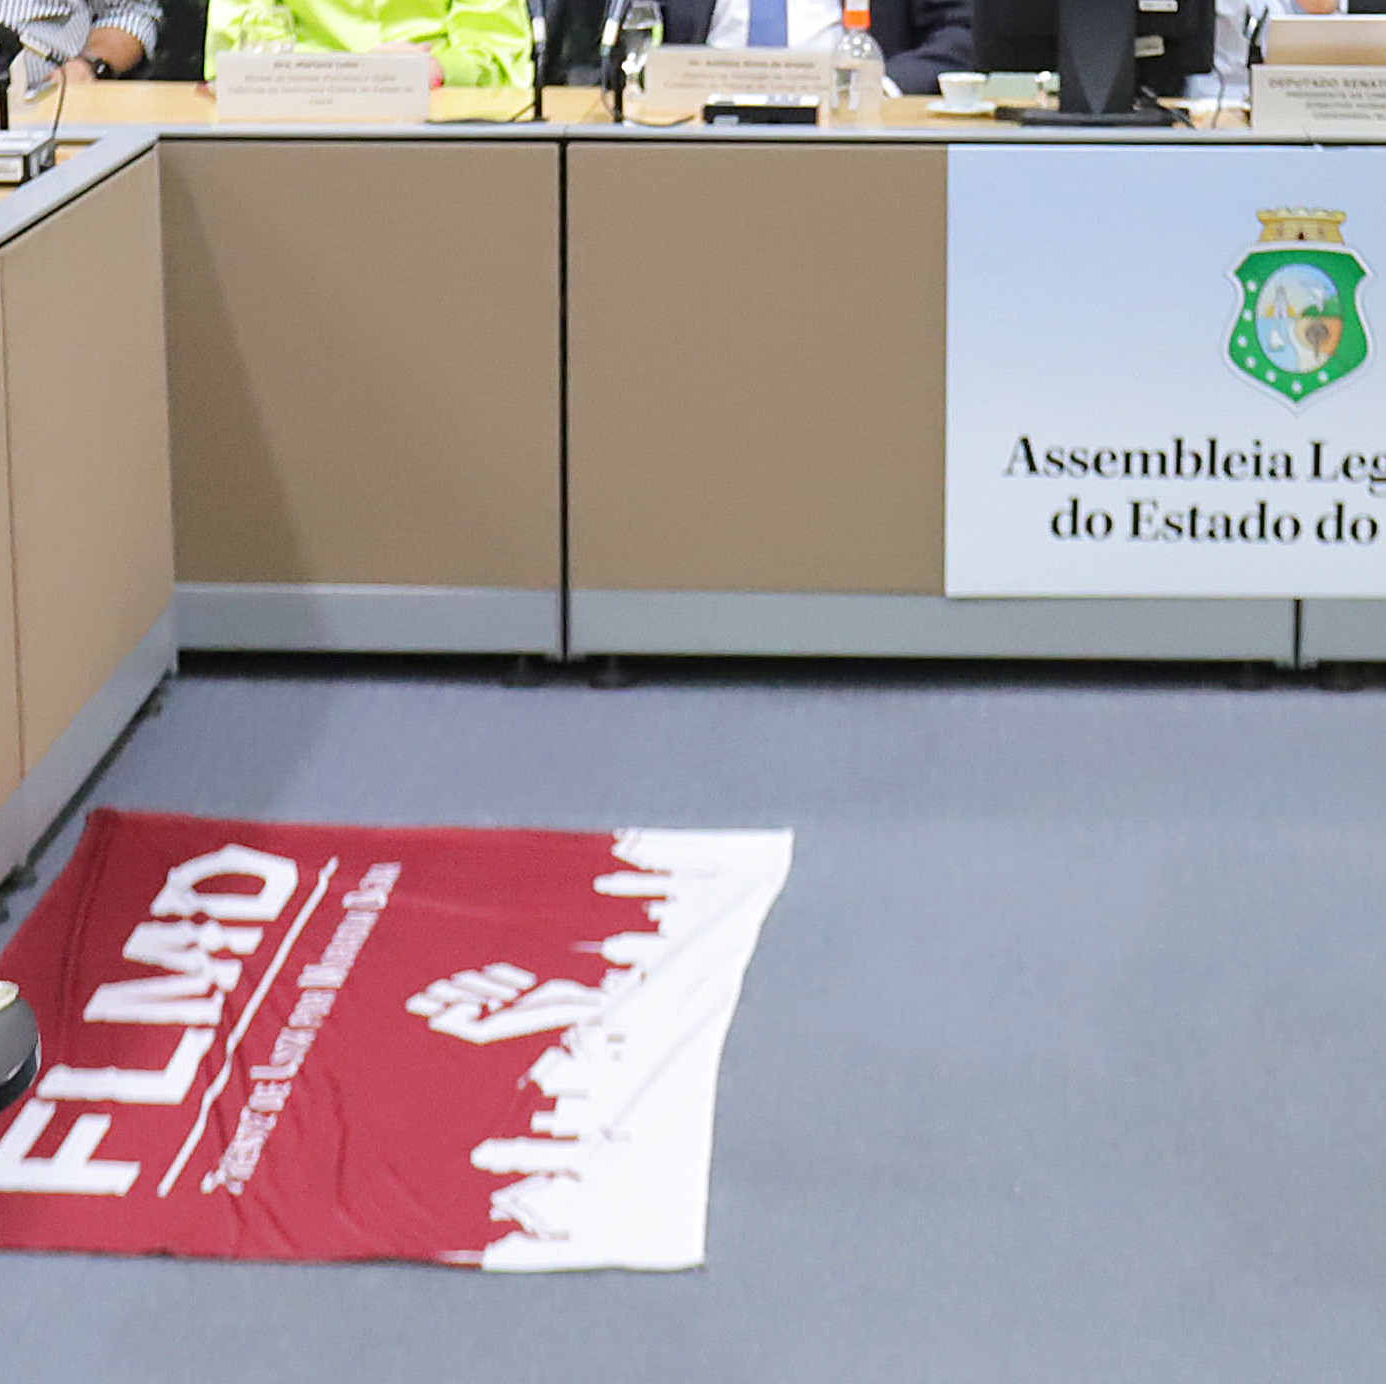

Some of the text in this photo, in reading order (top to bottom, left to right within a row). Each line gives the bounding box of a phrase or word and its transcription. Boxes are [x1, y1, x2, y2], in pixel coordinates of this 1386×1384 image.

[1003, 435, 1297, 481] Assembleia
[1050, 497, 1114, 541] do
[1127, 498, 1302, 544] Estado
[1315, 501, 1378, 545] do
